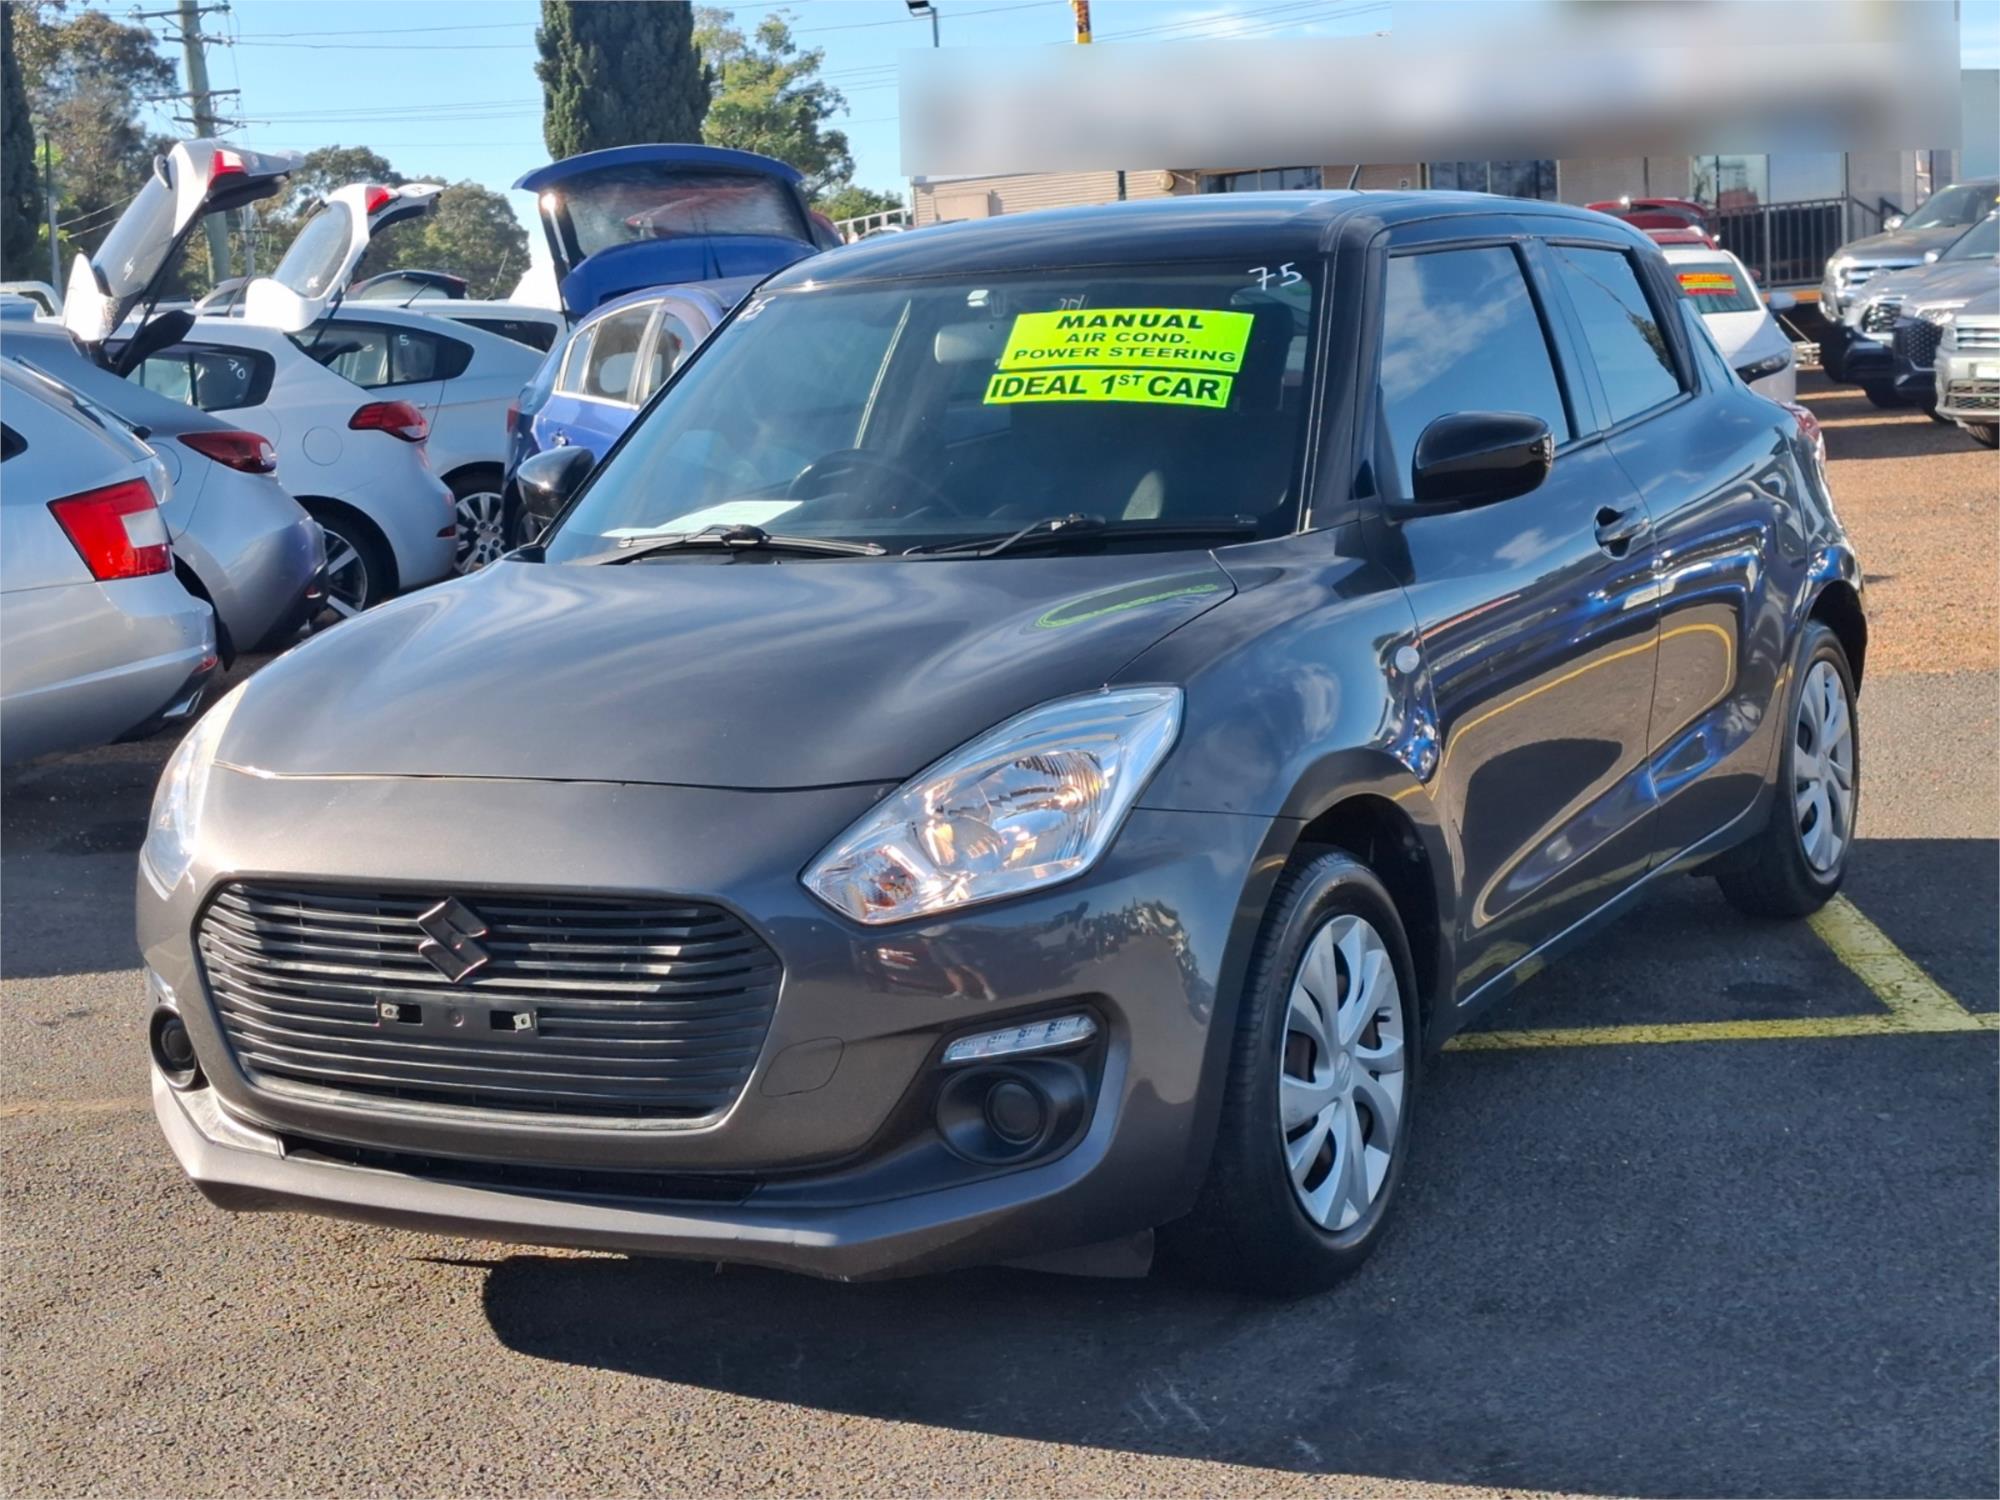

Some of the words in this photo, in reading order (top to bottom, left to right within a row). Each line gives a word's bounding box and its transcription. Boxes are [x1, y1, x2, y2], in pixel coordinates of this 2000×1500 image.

[1248, 261, 1303, 291] 75
[1056, 314, 1204, 330] MANUAL
[1065, 332, 1106, 344] AIR
[1115, 332, 1191, 345] COND.
[1013, 347, 1100, 361] POWER
[1108, 347, 1236, 363] STEERING
[990, 375, 1087, 398] IDEAL
[1101, 374, 1145, 395] 1ST
[1147, 375, 1220, 401] CAR
